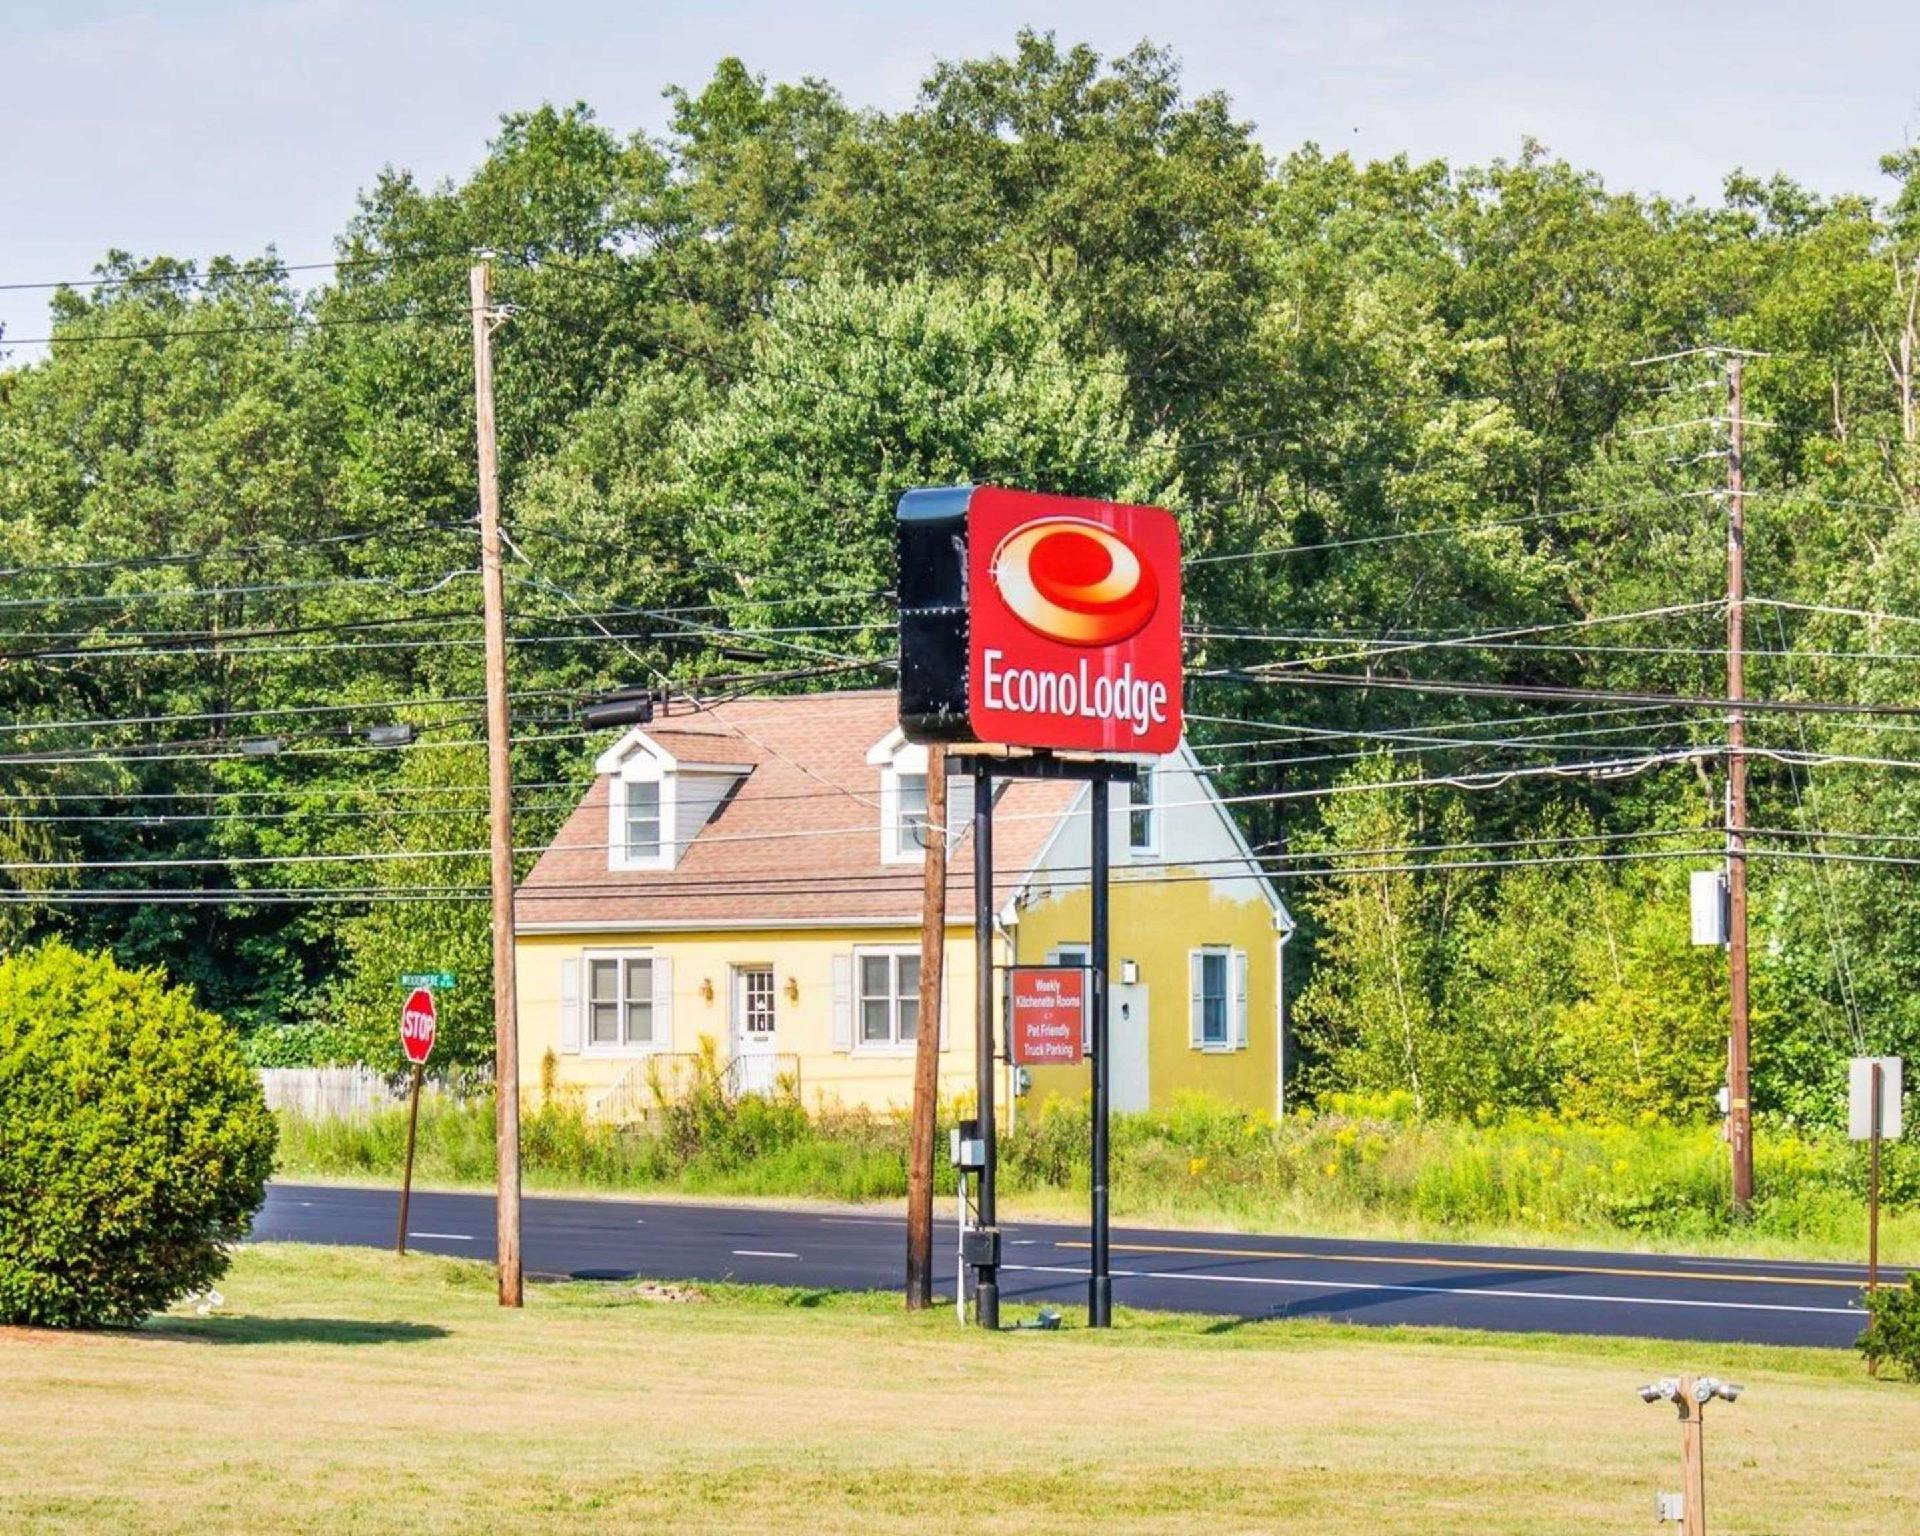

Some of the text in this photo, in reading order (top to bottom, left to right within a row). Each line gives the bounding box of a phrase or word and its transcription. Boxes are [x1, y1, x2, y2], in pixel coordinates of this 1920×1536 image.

[984, 649, 1168, 736] EconoLodge
[1035, 978, 1060, 994] Weekly
[1016, 995, 1080, 1008] Kitchenette Rooms
[404, 1010, 433, 1042] STOP
[1026, 1023, 1070, 1039] Pet Friendly
[1024, 1042, 1073, 1058] Truck Parking
